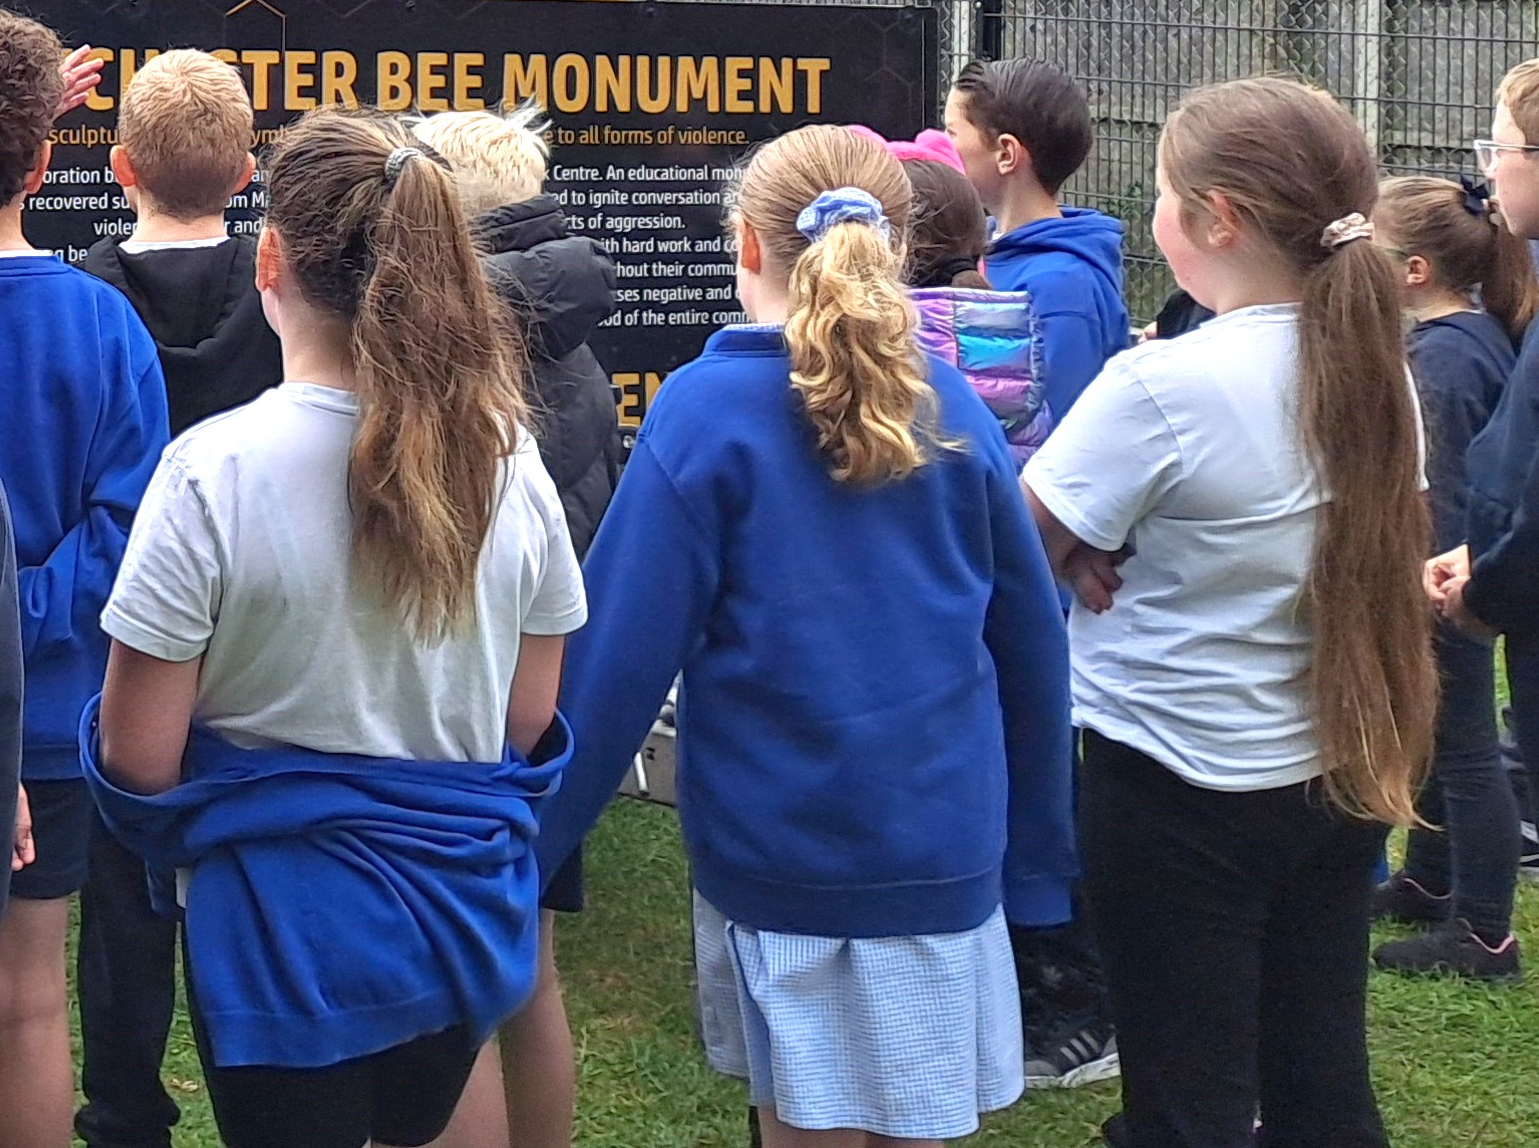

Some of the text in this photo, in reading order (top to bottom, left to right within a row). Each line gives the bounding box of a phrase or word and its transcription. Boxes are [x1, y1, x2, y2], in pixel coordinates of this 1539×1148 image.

[377, 52, 484, 111] BEE
[503, 52, 831, 114] MONUMENT
[558, 128, 575, 144] to
[579, 125, 600, 144] all
[603, 125, 653, 144] forms
[657, 125, 675, 144] of
[678, 126, 750, 145] violence.
[553, 165, 604, 181] Centre.
[606, 165, 625, 181] An
[628, 164, 709, 180] educational
[29, 192, 109, 210] recovered
[572, 190, 587, 205] to
[589, 190, 629, 208] ignite
[632, 190, 720, 204] conversation
[588, 213, 605, 229] of
[605, 213, 686, 232] aggression.
[623, 237, 654, 253] hard
[657, 237, 691, 252] work
[694, 237, 721, 252] and
[652, 262, 685, 277] their
[643, 285, 703, 304] negative
[705, 285, 732, 300] and
[624, 310, 640, 326] of
[642, 310, 665, 325] the
[668, 310, 710, 325] entire
